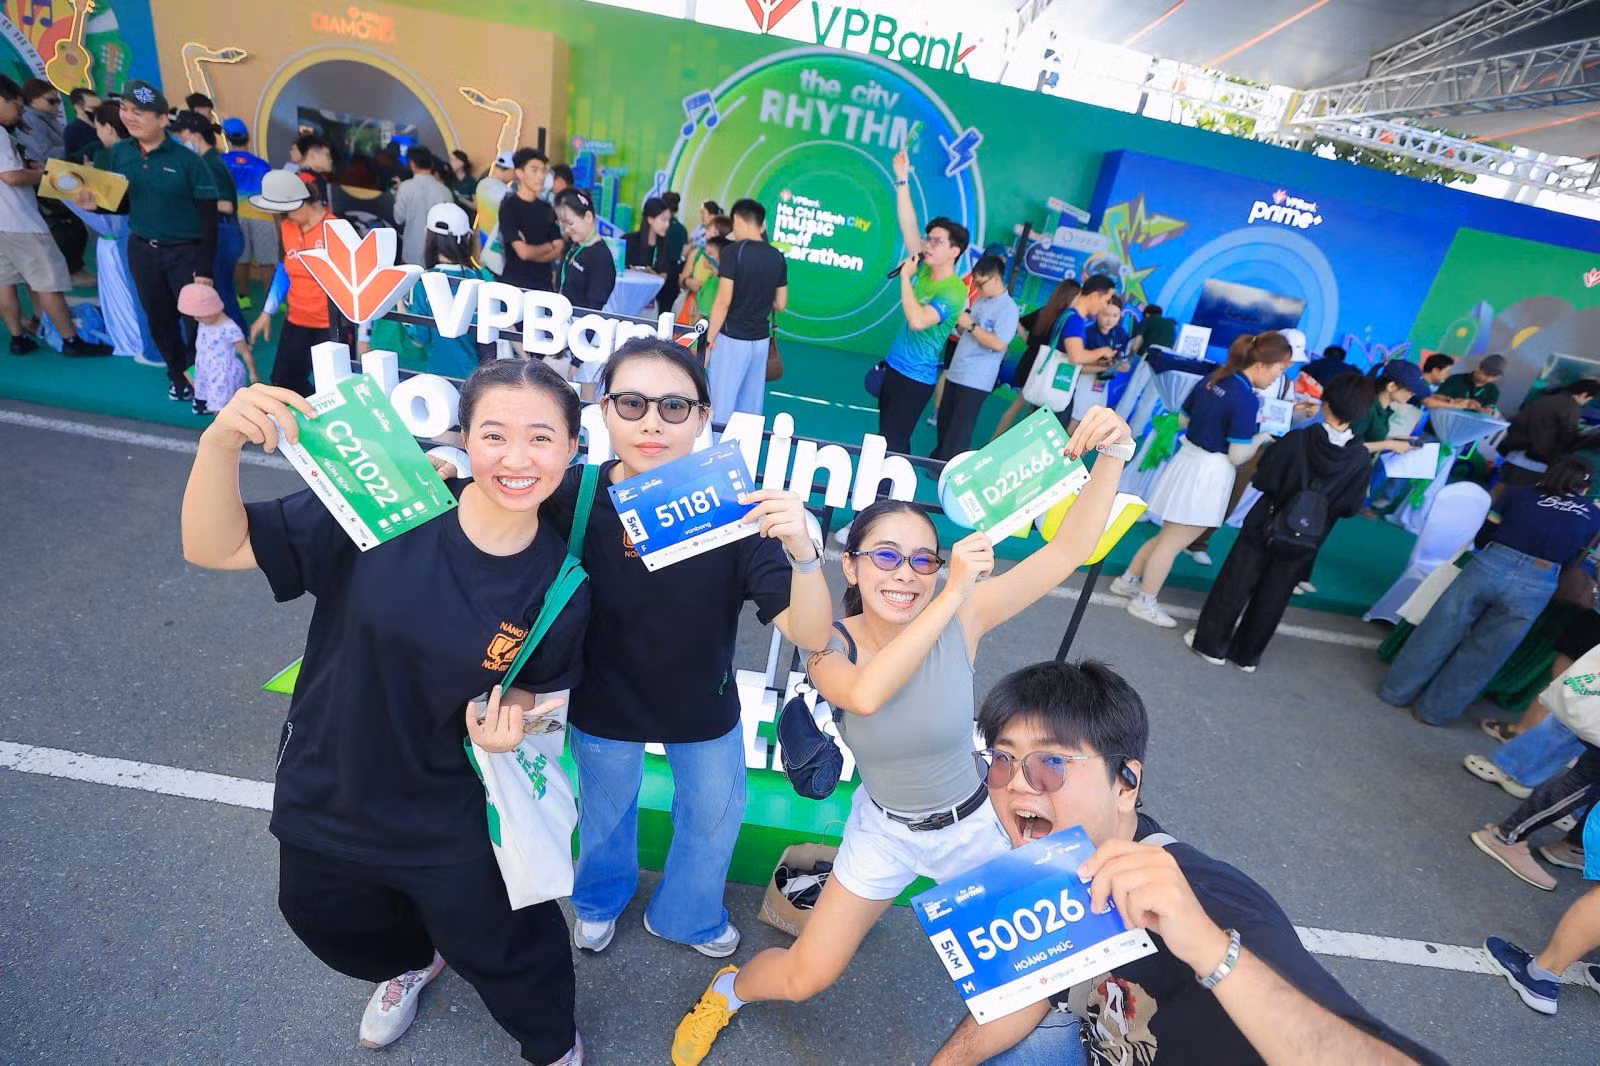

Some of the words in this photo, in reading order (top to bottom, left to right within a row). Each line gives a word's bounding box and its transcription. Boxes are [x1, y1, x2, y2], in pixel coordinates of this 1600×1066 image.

[811, 1, 977, 80] VPBank
[799, 68, 841, 99] the
[851, 80, 900, 110] city
[772, 226, 812, 248] half
[774, 213, 835, 237] music
[325, 420, 399, 508] C21022
[982, 446, 1055, 505] D22466
[655, 485, 721, 528] 51181
[627, 516, 641, 538] 5KM
[641, 544, 648, 552] F
[968, 888, 1086, 961] 50026
[941, 939, 963, 970] 5KM
[1048, 940, 1074, 959] PHÚC
[962, 981, 976, 994] M
